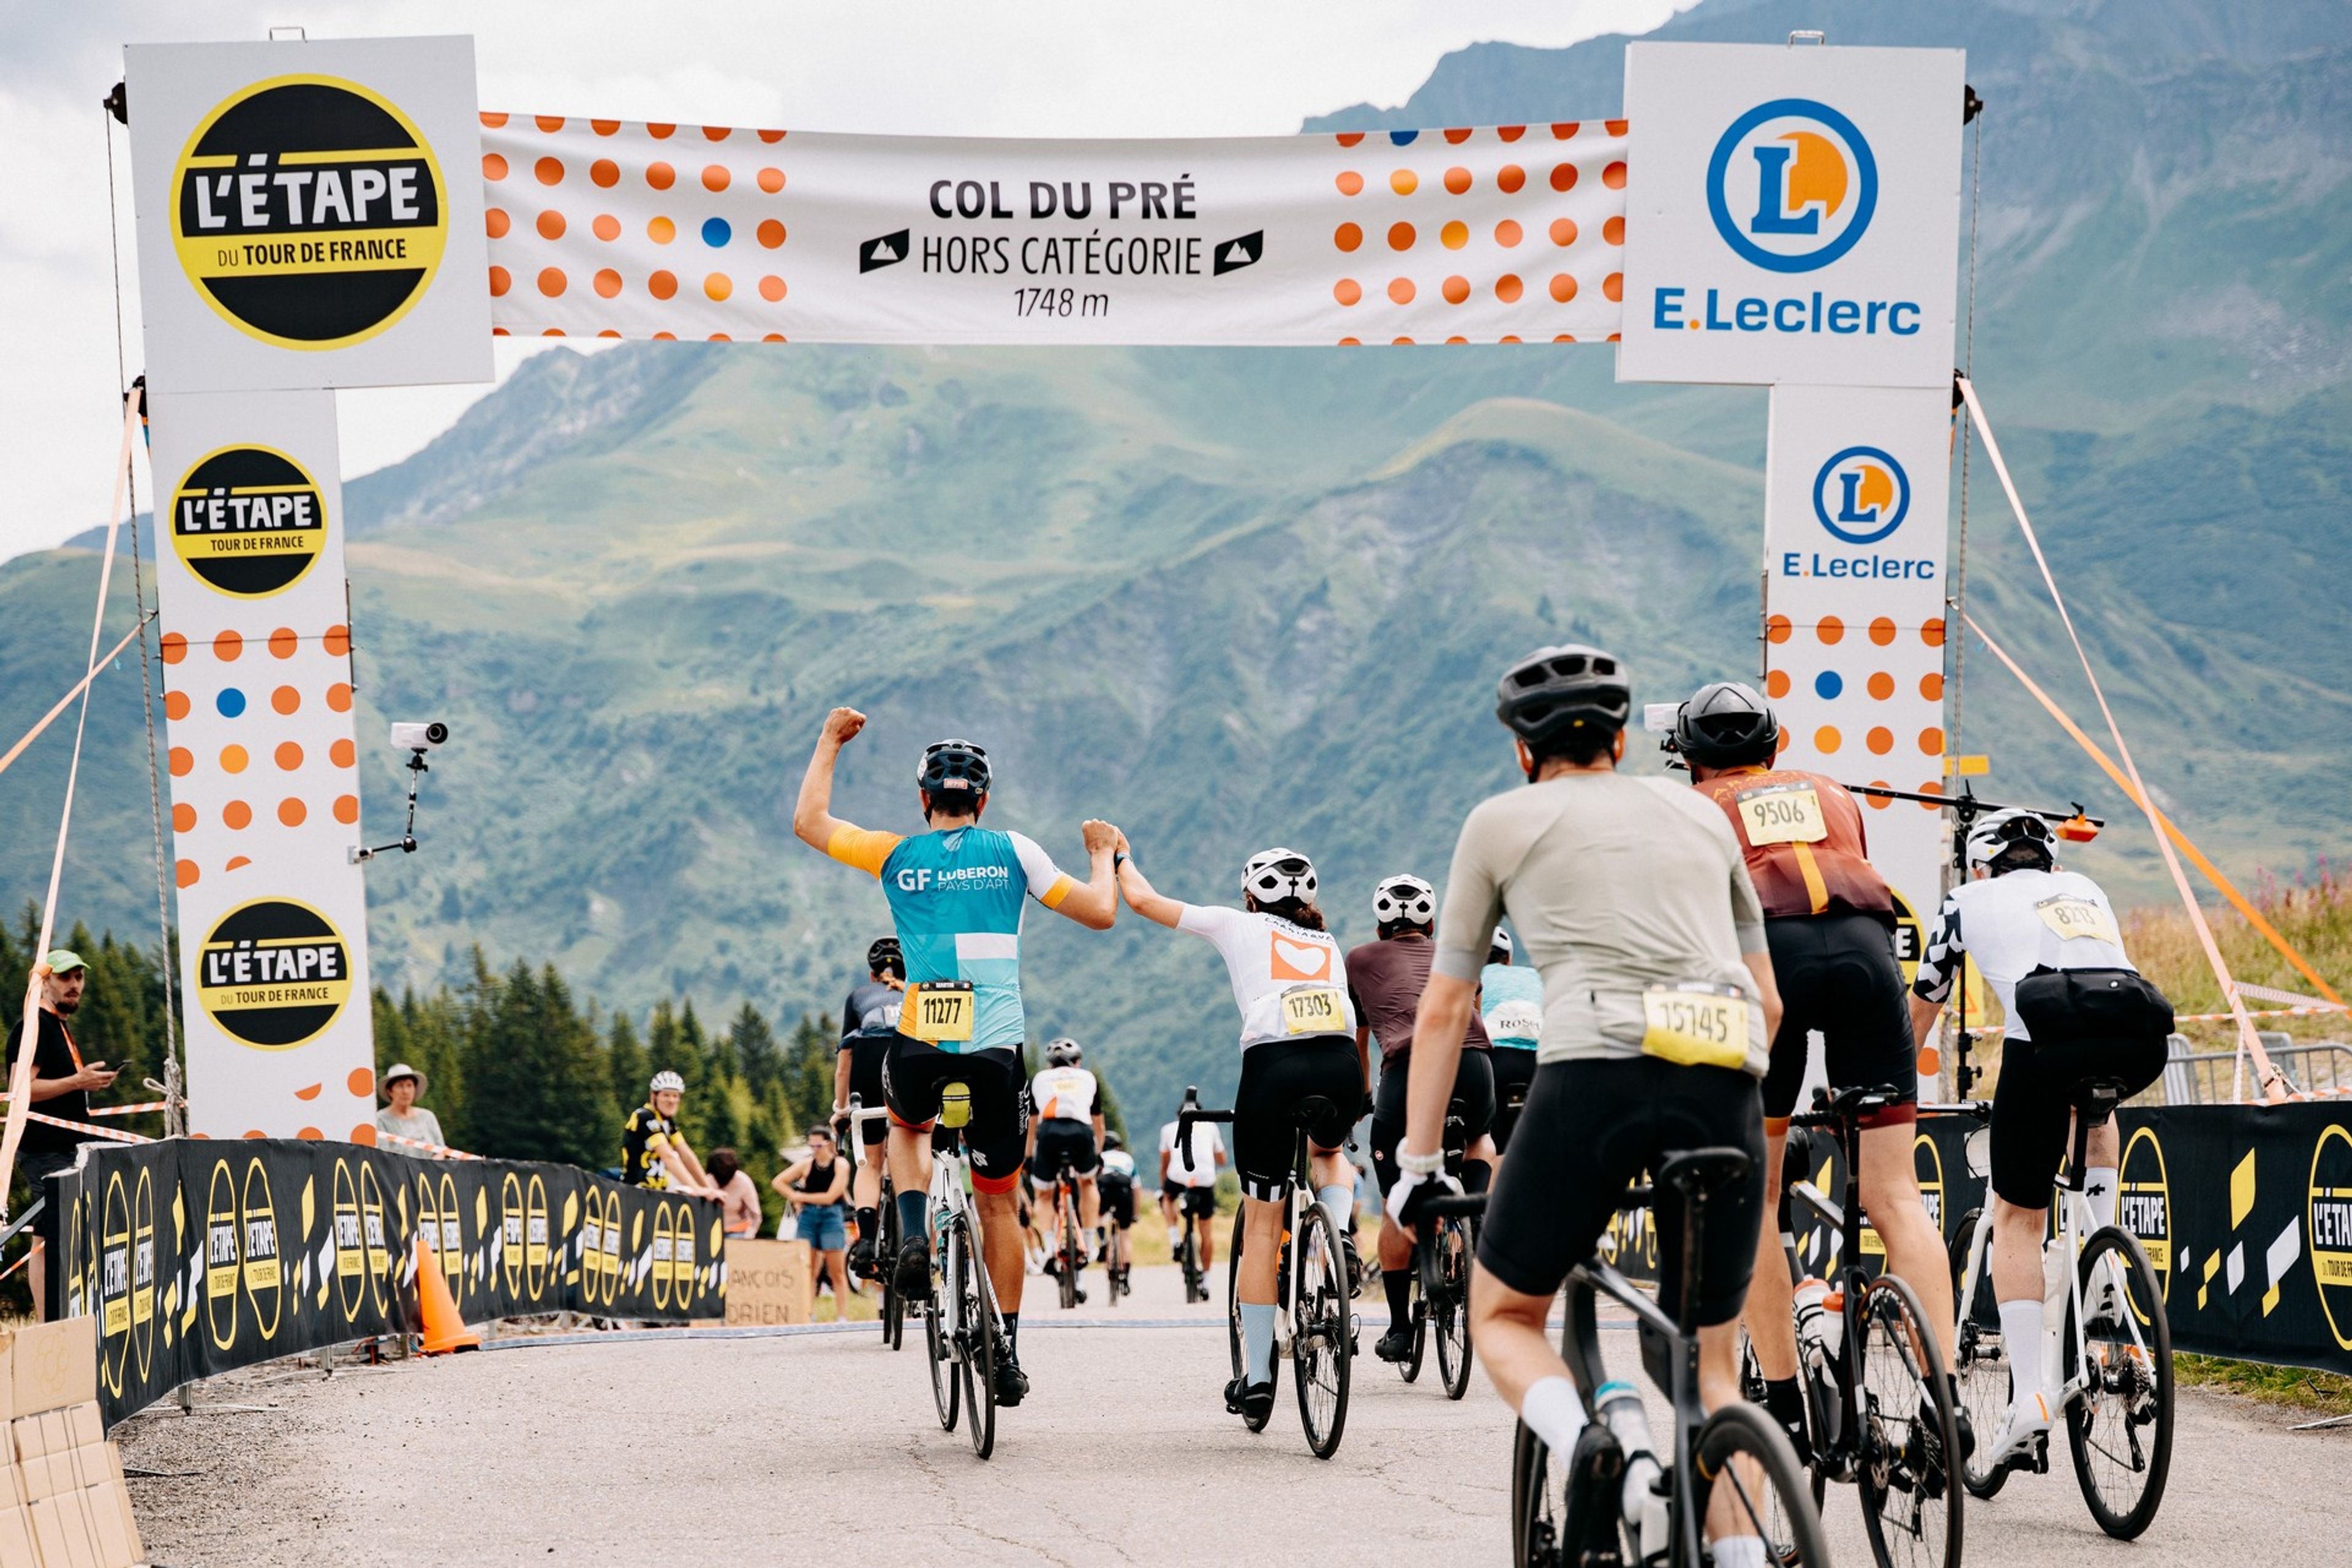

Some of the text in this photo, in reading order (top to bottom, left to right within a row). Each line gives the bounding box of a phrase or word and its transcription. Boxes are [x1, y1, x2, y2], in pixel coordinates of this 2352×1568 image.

[196, 153, 420, 228] L'ÉTAPE
[930, 173, 1196, 219] COL DU PRÉ
[218, 239, 406, 266] DU TOUR DE FRANCE
[922, 229, 1201, 274] HORS CATÉGORIE
[1014, 288, 1109, 317] 1748 m
[1654, 287, 1921, 335] E.Leclerc
[184, 488, 312, 531] L'ÉTAPE
[211, 536, 304, 551] TOUR DE FRANCE
[1783, 552, 1935, 579] E.Leclerc
[1754, 799, 1804, 827] 9506
[897, 869, 932, 891] GF
[938, 866, 1008, 881] LUBERON
[938, 880, 1009, 891] PAYS D'APT
[209, 940, 337, 984] L'ÉTAPE
[236, 991, 265, 1004] TOUR
[268, 990, 282, 1001] DE
[285, 987, 328, 1000] FRANCE
[1289, 993, 1331, 1018] 17303
[924, 998, 962, 1023] 11277
[1660, 1001, 1727, 1043] 15145
